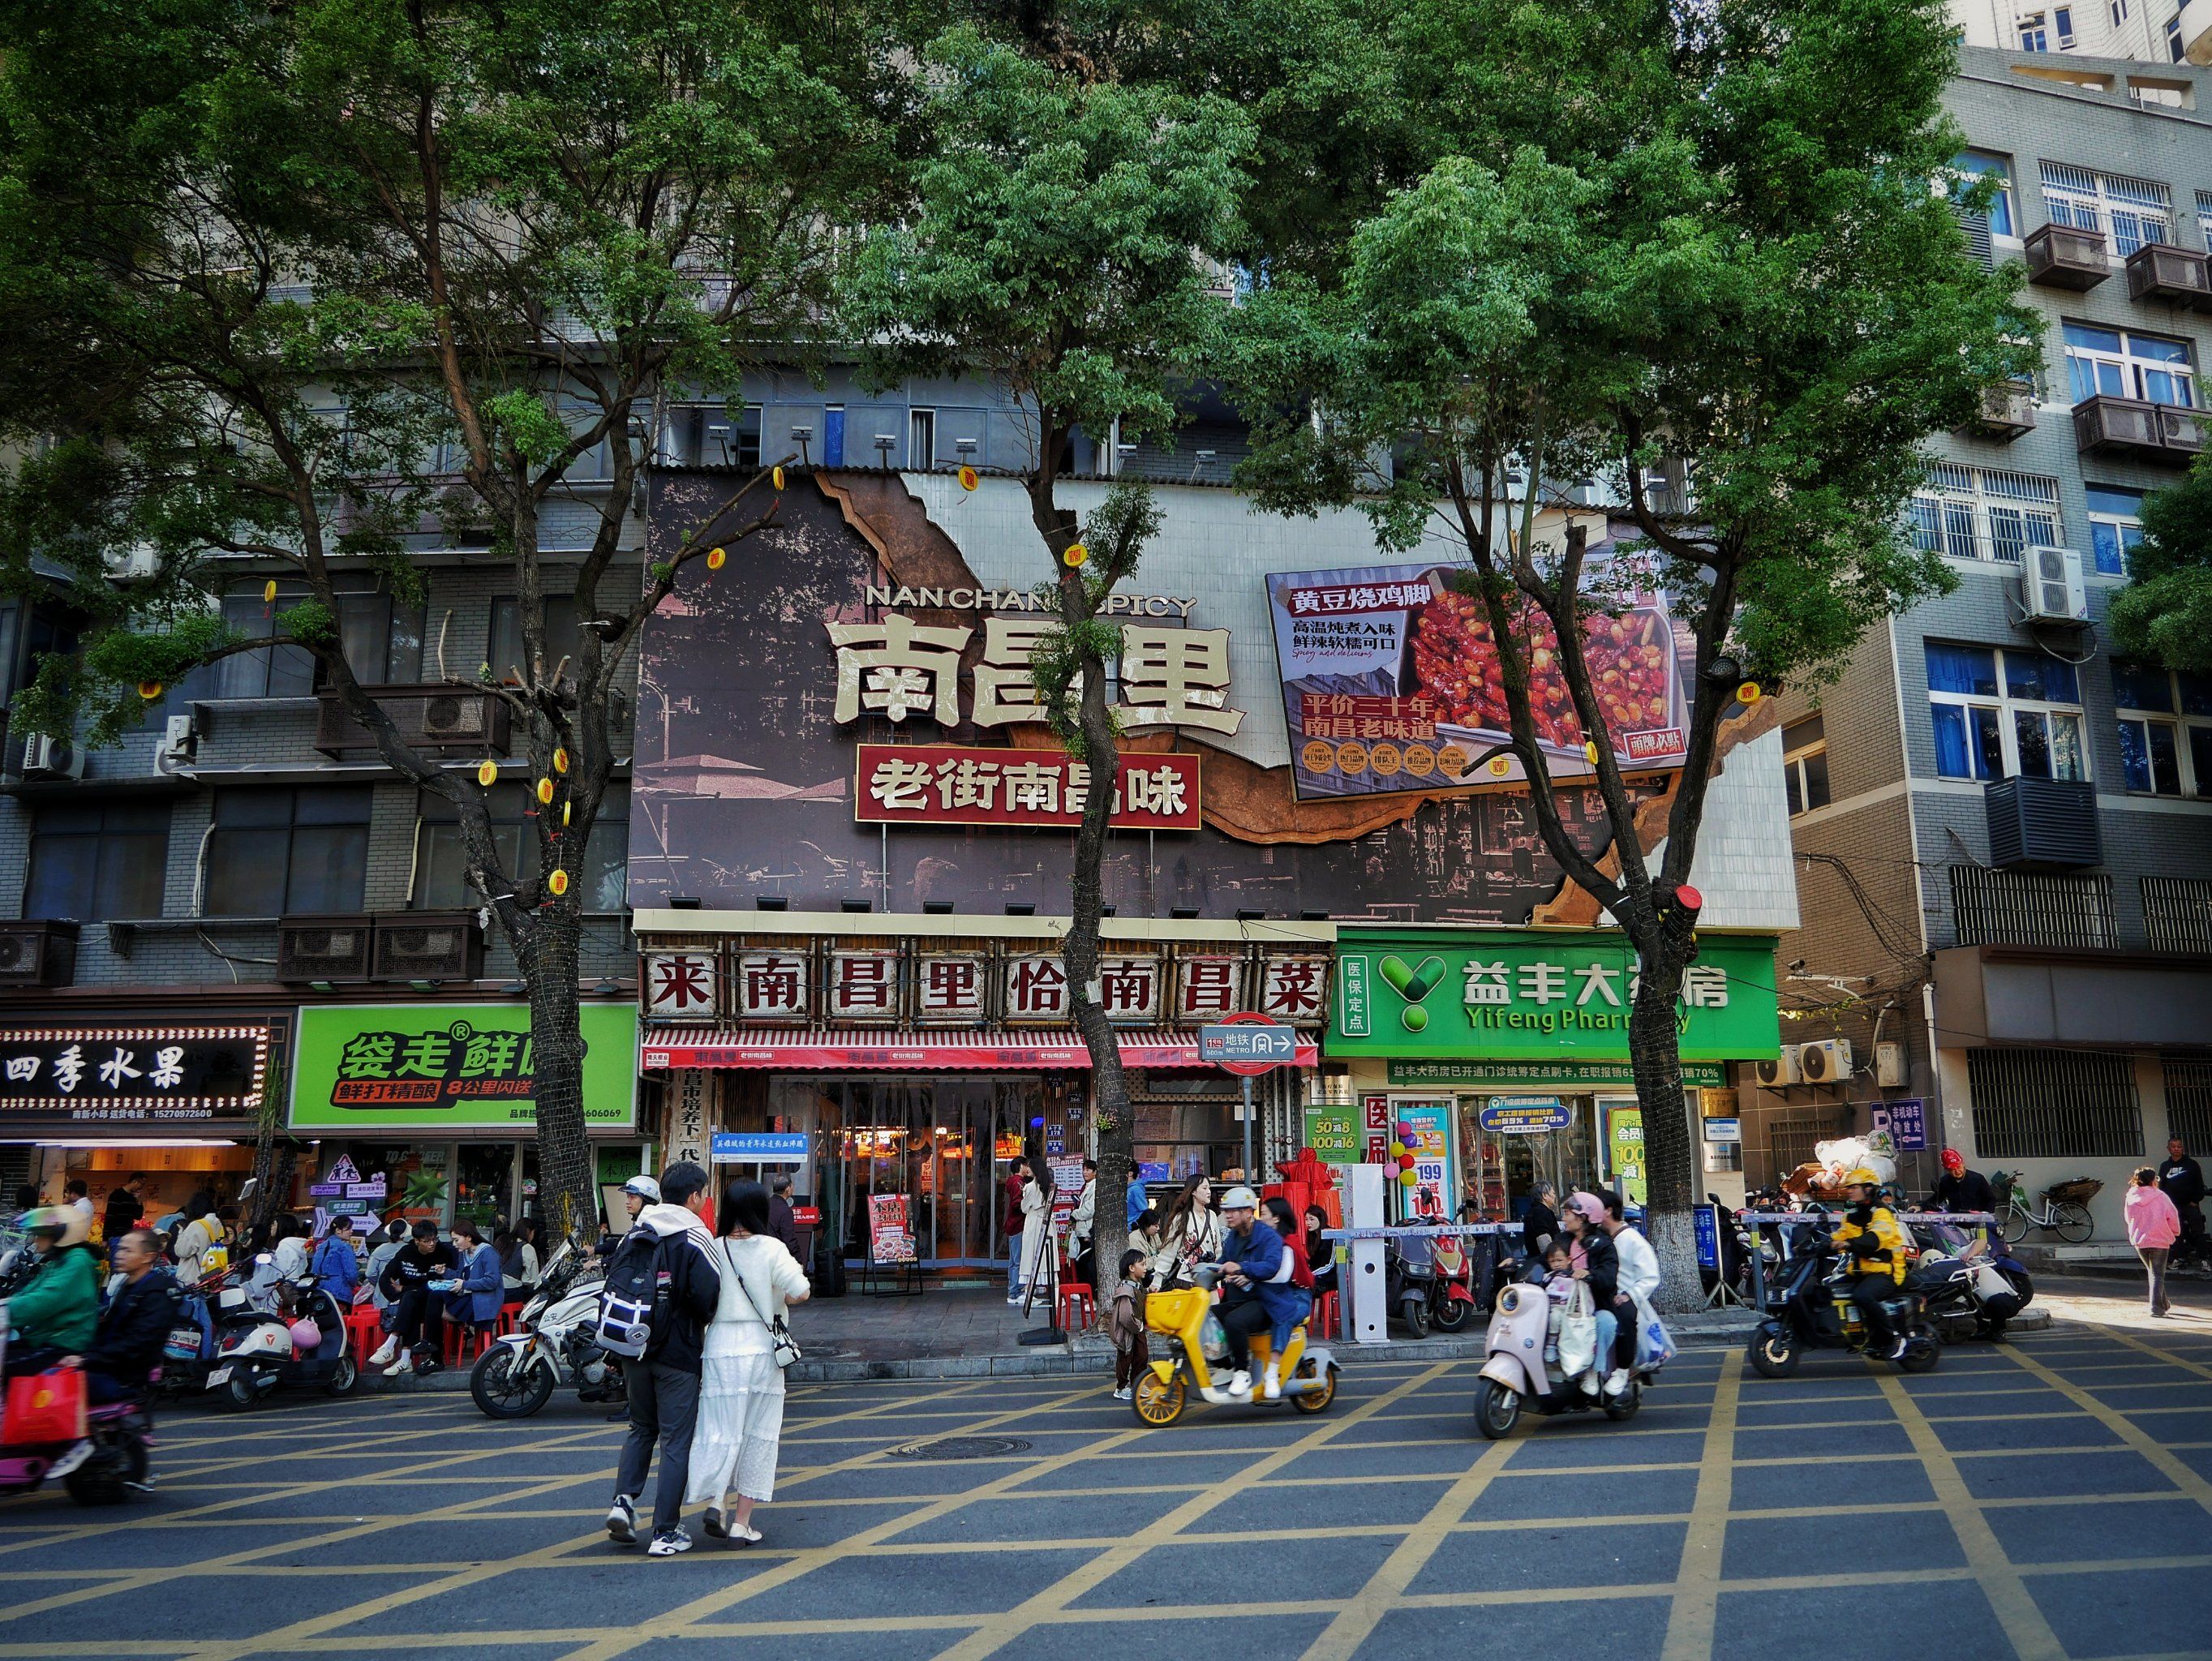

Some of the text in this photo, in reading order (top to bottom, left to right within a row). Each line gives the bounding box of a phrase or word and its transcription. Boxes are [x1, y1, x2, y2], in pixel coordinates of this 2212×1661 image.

[866, 586, 1063, 612] NANCHAN
[1292, 584, 1431, 614] 黄豆烧鸡脚
[1292, 620, 1396, 636] 高温炖煮入味
[1293, 635, 1395, 650] 鲜辣软糯可口
[1292, 648, 1372, 663] Spicy and delicious
[823, 613, 1246, 736] 南昌里
[1304, 694, 1434, 718] 平价三十年
[1304, 717, 1436, 740] 南昌老味道
[1630, 732, 1681, 755] 頭牌必點
[1340, 755, 1364, 763] 热门品牌
[1374, 756, 1397, 764] 排队王
[1407, 757, 1431, 765] 推荐品牌
[1440, 758, 1466, 766] 影响力品牌
[870, 758, 1185, 815] 老街南昌味
[654, 956, 1321, 1013] 来南昌里恰南昌菜
[1347, 962, 1364, 1030] 医保定点
[1466, 1007, 1691, 1035] Yifeng Phary
[1226, 1032, 1249, 1046] 地铁
[6, 1044, 185, 1092] 四季水果
[338, 1084, 439, 1101] 鲜打精酿
[680, 1067, 702, 1165] 昌市培养下一代
[1892, 1105, 1920, 1118] 非机动车
[1315, 1122, 1351, 1134] 50减8
[1617, 1127, 1643, 1140] 会员
[1893, 1121, 1922, 1134] 停放处
[1312, 1136, 1355, 1149] 100减16
[1417, 1165, 1441, 1180] 199
[543, 1312, 557, 1322] 公安
